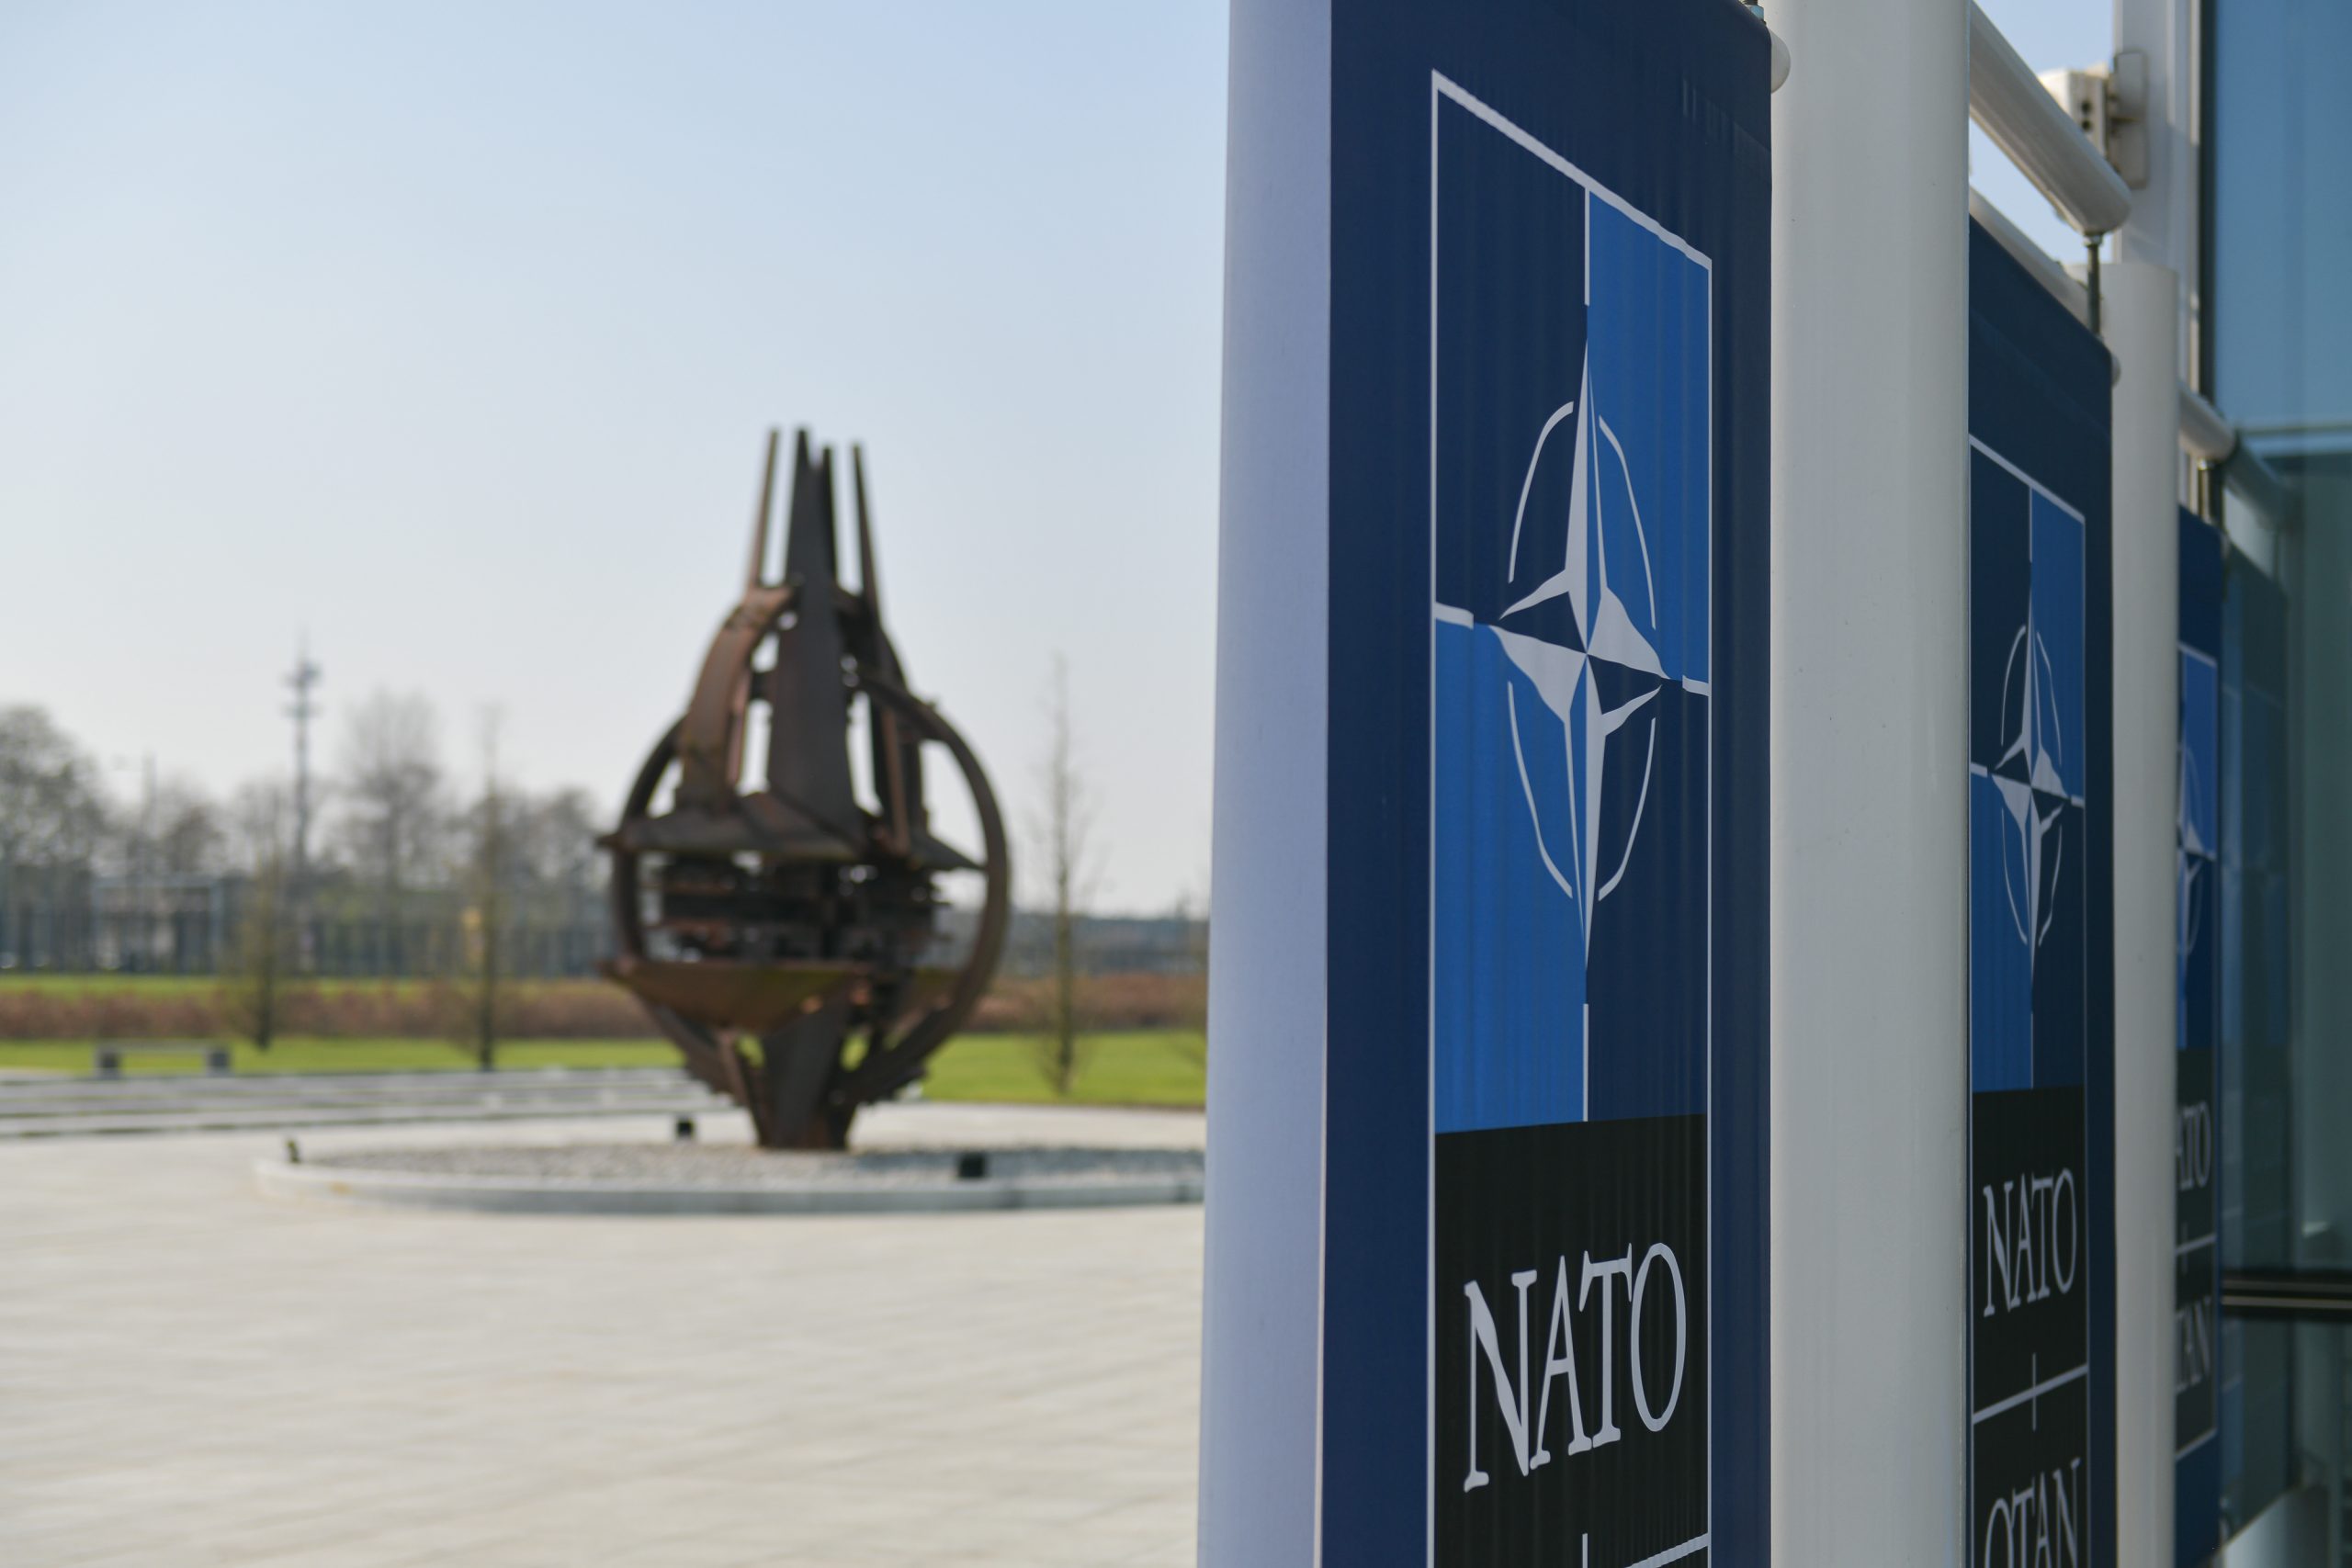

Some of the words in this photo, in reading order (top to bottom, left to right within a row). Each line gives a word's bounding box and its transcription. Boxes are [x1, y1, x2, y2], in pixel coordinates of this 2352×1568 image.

[2176, 1101, 2211, 1191] ATO
[1983, 1167, 2077, 1317] NATO
[1464, 1242, 1686, 1493] NATO
[1984, 1457, 2081, 1568] OTAN
